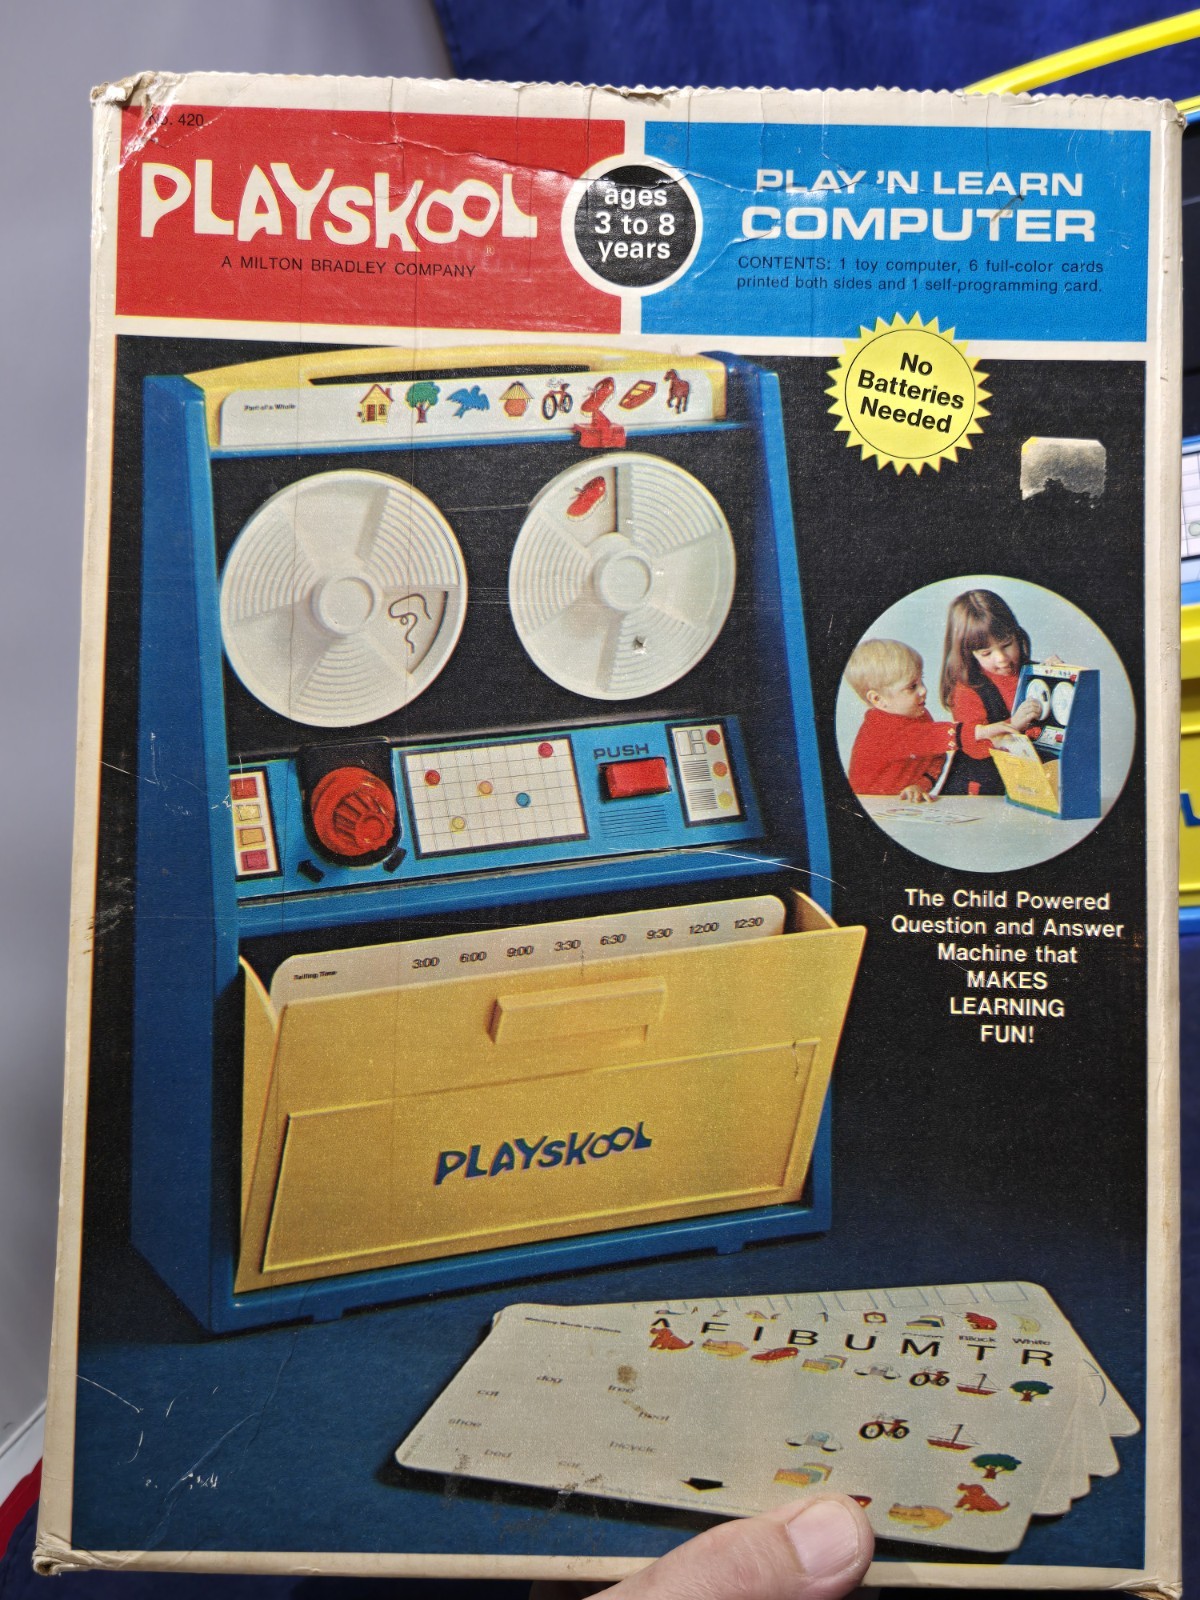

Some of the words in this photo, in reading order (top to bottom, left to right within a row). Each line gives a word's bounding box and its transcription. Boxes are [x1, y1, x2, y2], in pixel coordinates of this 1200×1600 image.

[178, 113, 204, 127] 420
[756, 168, 867, 194] PLAY
[934, 170, 1083, 197] LEARN
[140, 158, 537, 253] PLAYSKOOL
[604, 187, 668, 210] ages
[594, 211, 611, 234] 3
[621, 214, 648, 235] to
[658, 213, 675, 236] 8
[741, 205, 1095, 243] COMPUTER
[598, 240, 671, 263] years
[221, 255, 232, 268] A
[240, 256, 302, 271] MILTON
[311, 258, 386, 275] BRADLEY
[394, 262, 476, 278] COMPANY
[738, 256, 831, 271] CONTENTS:
[839, 257, 846, 270] 1
[856, 258, 878, 274] toy
[886, 259, 961, 275] computer,
[969, 259, 978, 272] 6
[986, 260, 1053, 273] full-color
[1061, 260, 1104, 273] cards
[737, 275, 789, 290] printed
[795, 276, 828, 289] both
[833, 277, 873, 290] sides
[878, 278, 906, 290] and
[912, 278, 918, 290] 1
[925, 278, 1058, 295] self-programming
[1063, 279, 1103, 292] card.
[900, 352, 933, 376] No
[857, 369, 965, 410] Batteries
[859, 396, 953, 434] Needed
[593, 743, 650, 760] PUSH
[904, 888, 945, 907] The
[953, 889, 1008, 909] Child
[1016, 891, 1111, 911] Powered
[891, 914, 987, 935] Question
[995, 918, 1035, 936] and
[1043, 918, 1125, 938] Answer
[411, 956, 440, 969] 3:00
[459, 951, 487, 963] 6:00
[506, 945, 534, 958] 9:00
[554, 939, 581, 952] 3:30
[600, 933, 627, 946] 6:30
[646, 927, 673, 940] 9:30
[689, 921, 719, 935] 12:00
[733, 916, 765, 930] 12:30
[937, 942, 1028, 962] Machine
[1035, 945, 1078, 964] that
[967, 970, 1048, 990] MAKES
[950, 997, 1065, 1018] LEARNING
[980, 1024, 1035, 1043] FUN!
[433, 1121, 653, 1186] PLAYSKOOL
[788, 1328, 819, 1346] B
[844, 1333, 877, 1351] U
[901, 1338, 941, 1357] M
[967, 1343, 997, 1361] T
[1021, 1348, 1054, 1367] R
[958, 1334, 997, 1343] Black
[1012, 1337, 1051, 1346] White
[536, 1375, 563, 1384] dog
